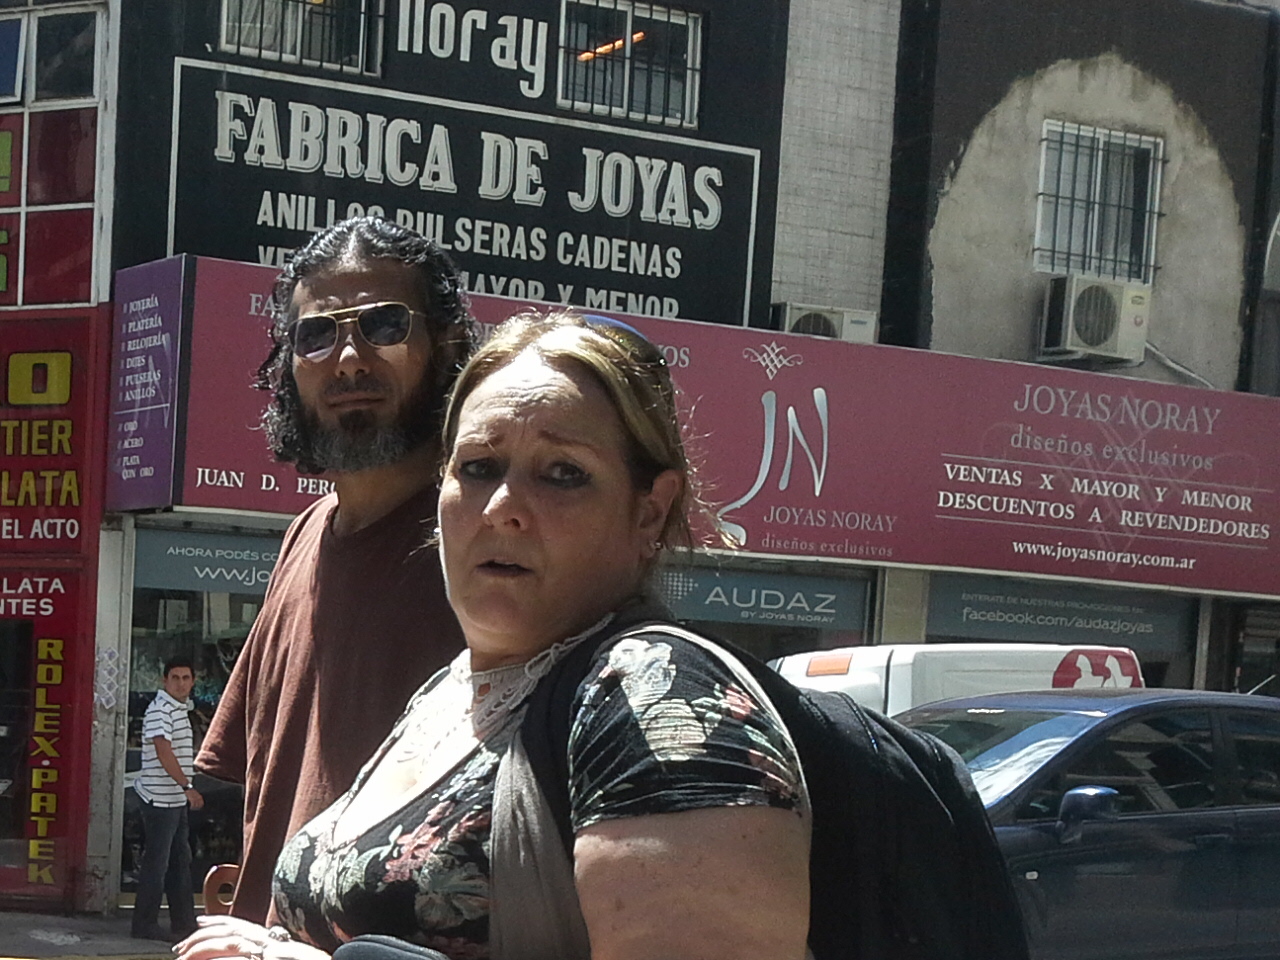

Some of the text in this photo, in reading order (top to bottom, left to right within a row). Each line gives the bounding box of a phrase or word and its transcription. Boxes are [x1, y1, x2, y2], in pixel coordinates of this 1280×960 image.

[214, 90, 723, 230] FABRICA DE JOYAS
[557, 231, 682, 279] CADENAS
[1014, 384, 1221, 435] JOYAS NORAY
[1010, 424, 1213, 470] diseños exclusivos
[196, 467, 336, 496] JUAN D. PER
[944, 463, 1253, 512] VENTAS X MAYOR Y MENOR
[1, 519, 24, 540] EL
[30, 518, 79, 540] ACTO
[763, 506, 897, 533] JOYAS NORAY
[937, 491, 1270, 540] DESCUENTOS A REVENDEDORES
[167, 547, 213, 558] AHORA
[761, 536, 893, 558] diseños exclusivos
[1012, 540, 1196, 570] www.joyasnoray.com.ar
[704, 586, 836, 613] AUDAZ
[759, 612, 794, 620] JOYAS
[797, 614, 835, 623] NORAY
[963, 607, 1154, 634] facebook.com/audazjoyas
[27, 638, 64, 885] ROLEX PATEK
